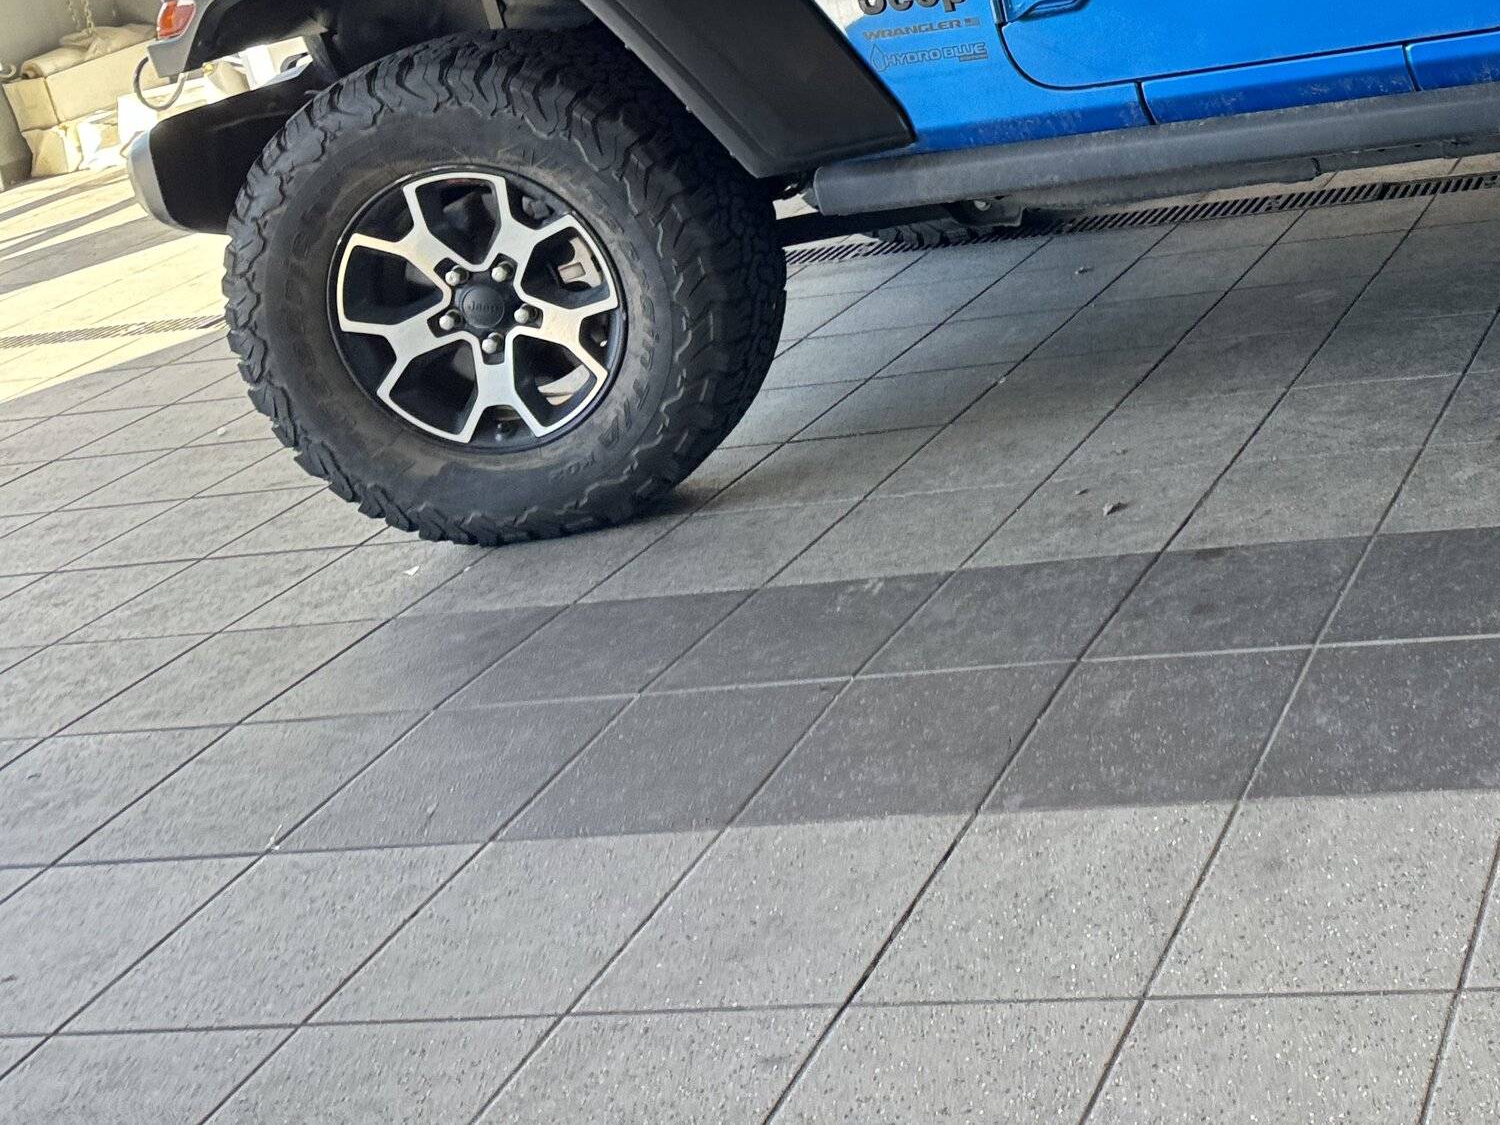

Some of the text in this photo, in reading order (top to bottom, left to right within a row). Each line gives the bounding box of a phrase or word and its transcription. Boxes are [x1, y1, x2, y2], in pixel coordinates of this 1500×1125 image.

[862, 19, 962, 40] WRANGLER
[885, 47, 942, 67] HYDRO
[942, 41, 988, 59] BLUE
